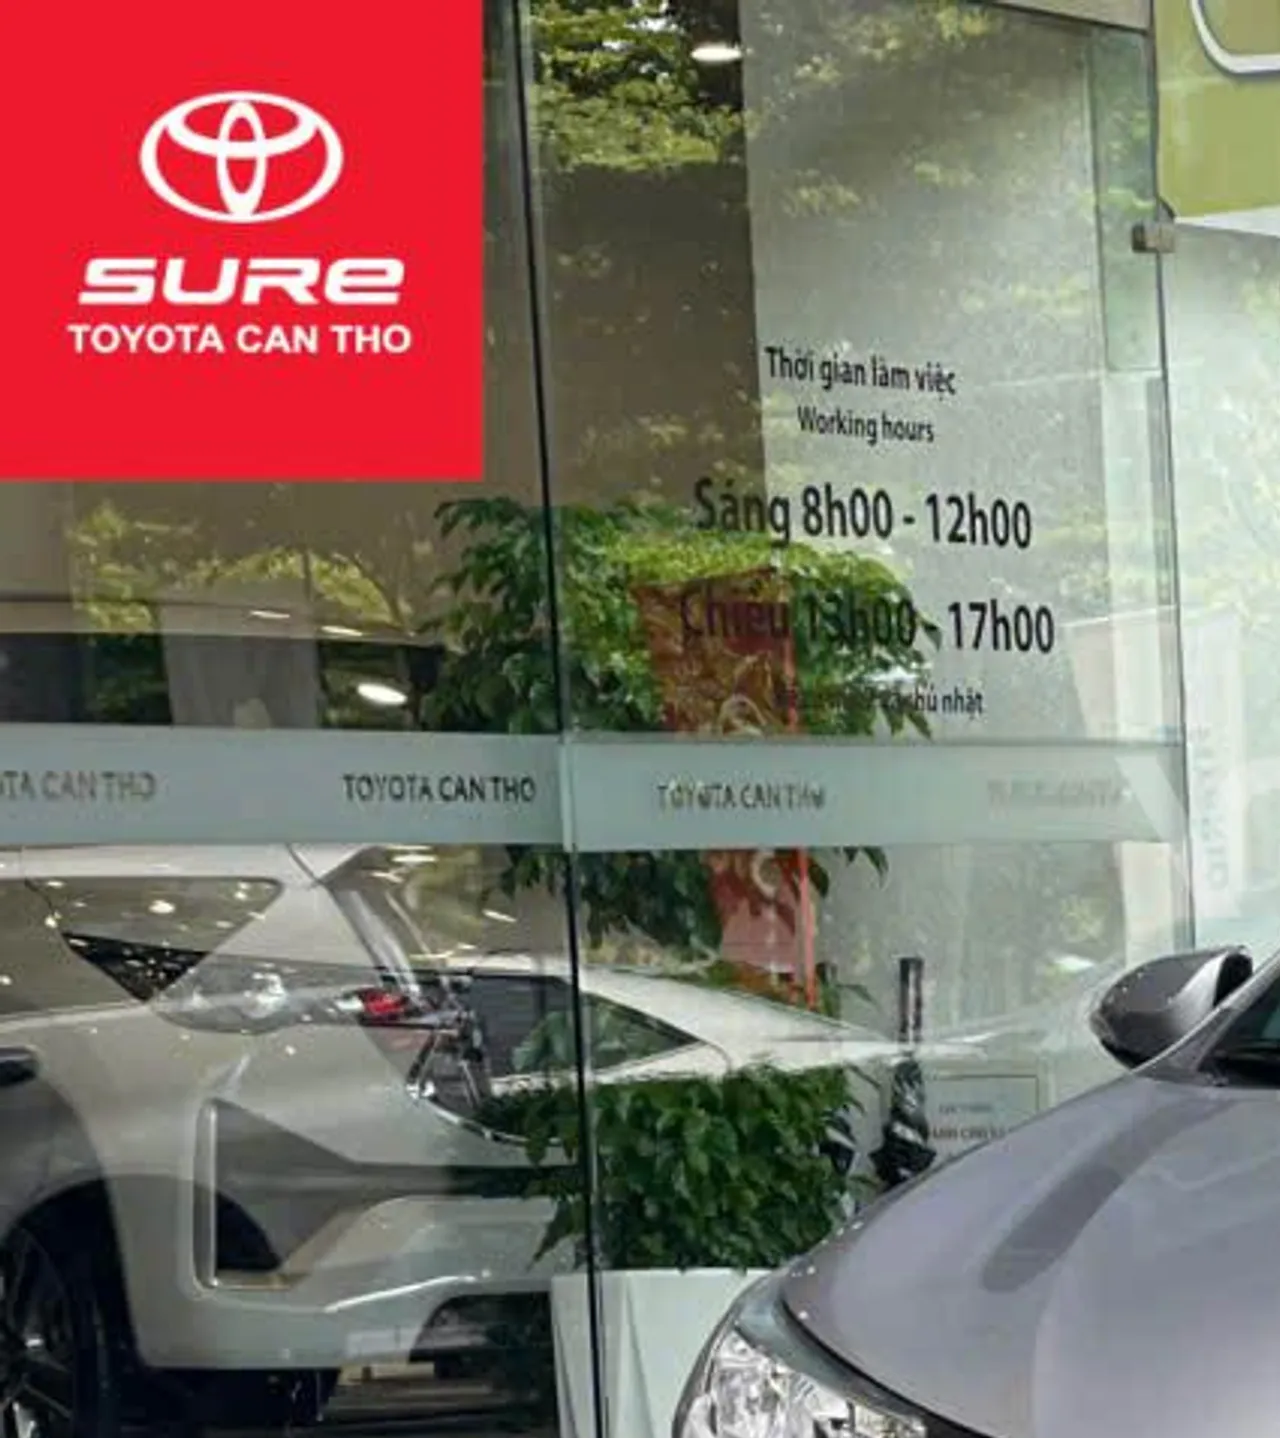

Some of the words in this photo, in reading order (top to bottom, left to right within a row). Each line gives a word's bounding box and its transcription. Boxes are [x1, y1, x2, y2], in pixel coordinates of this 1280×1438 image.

[764, 345, 814, 382] Thời
[819, 352, 866, 391] gian
[870, 353, 911, 391] làm
[914, 361, 957, 401] việc
[797, 404, 877, 446] Working
[881, 410, 934, 443] hours
[694, 477, 791, 549] Sáng
[802, 483, 894, 540] 8h00
[925, 492, 1032, 550] 12h00
[805, 588, 918, 648] 13h00
[948, 598, 1055, 654] 17h00
[41, 770, 97, 800] CAN
[101, 771, 157, 801] THO
[341, 774, 434, 802] TOYOTA
[438, 775, 486, 802] CAN
[488, 776, 537, 804] THO
